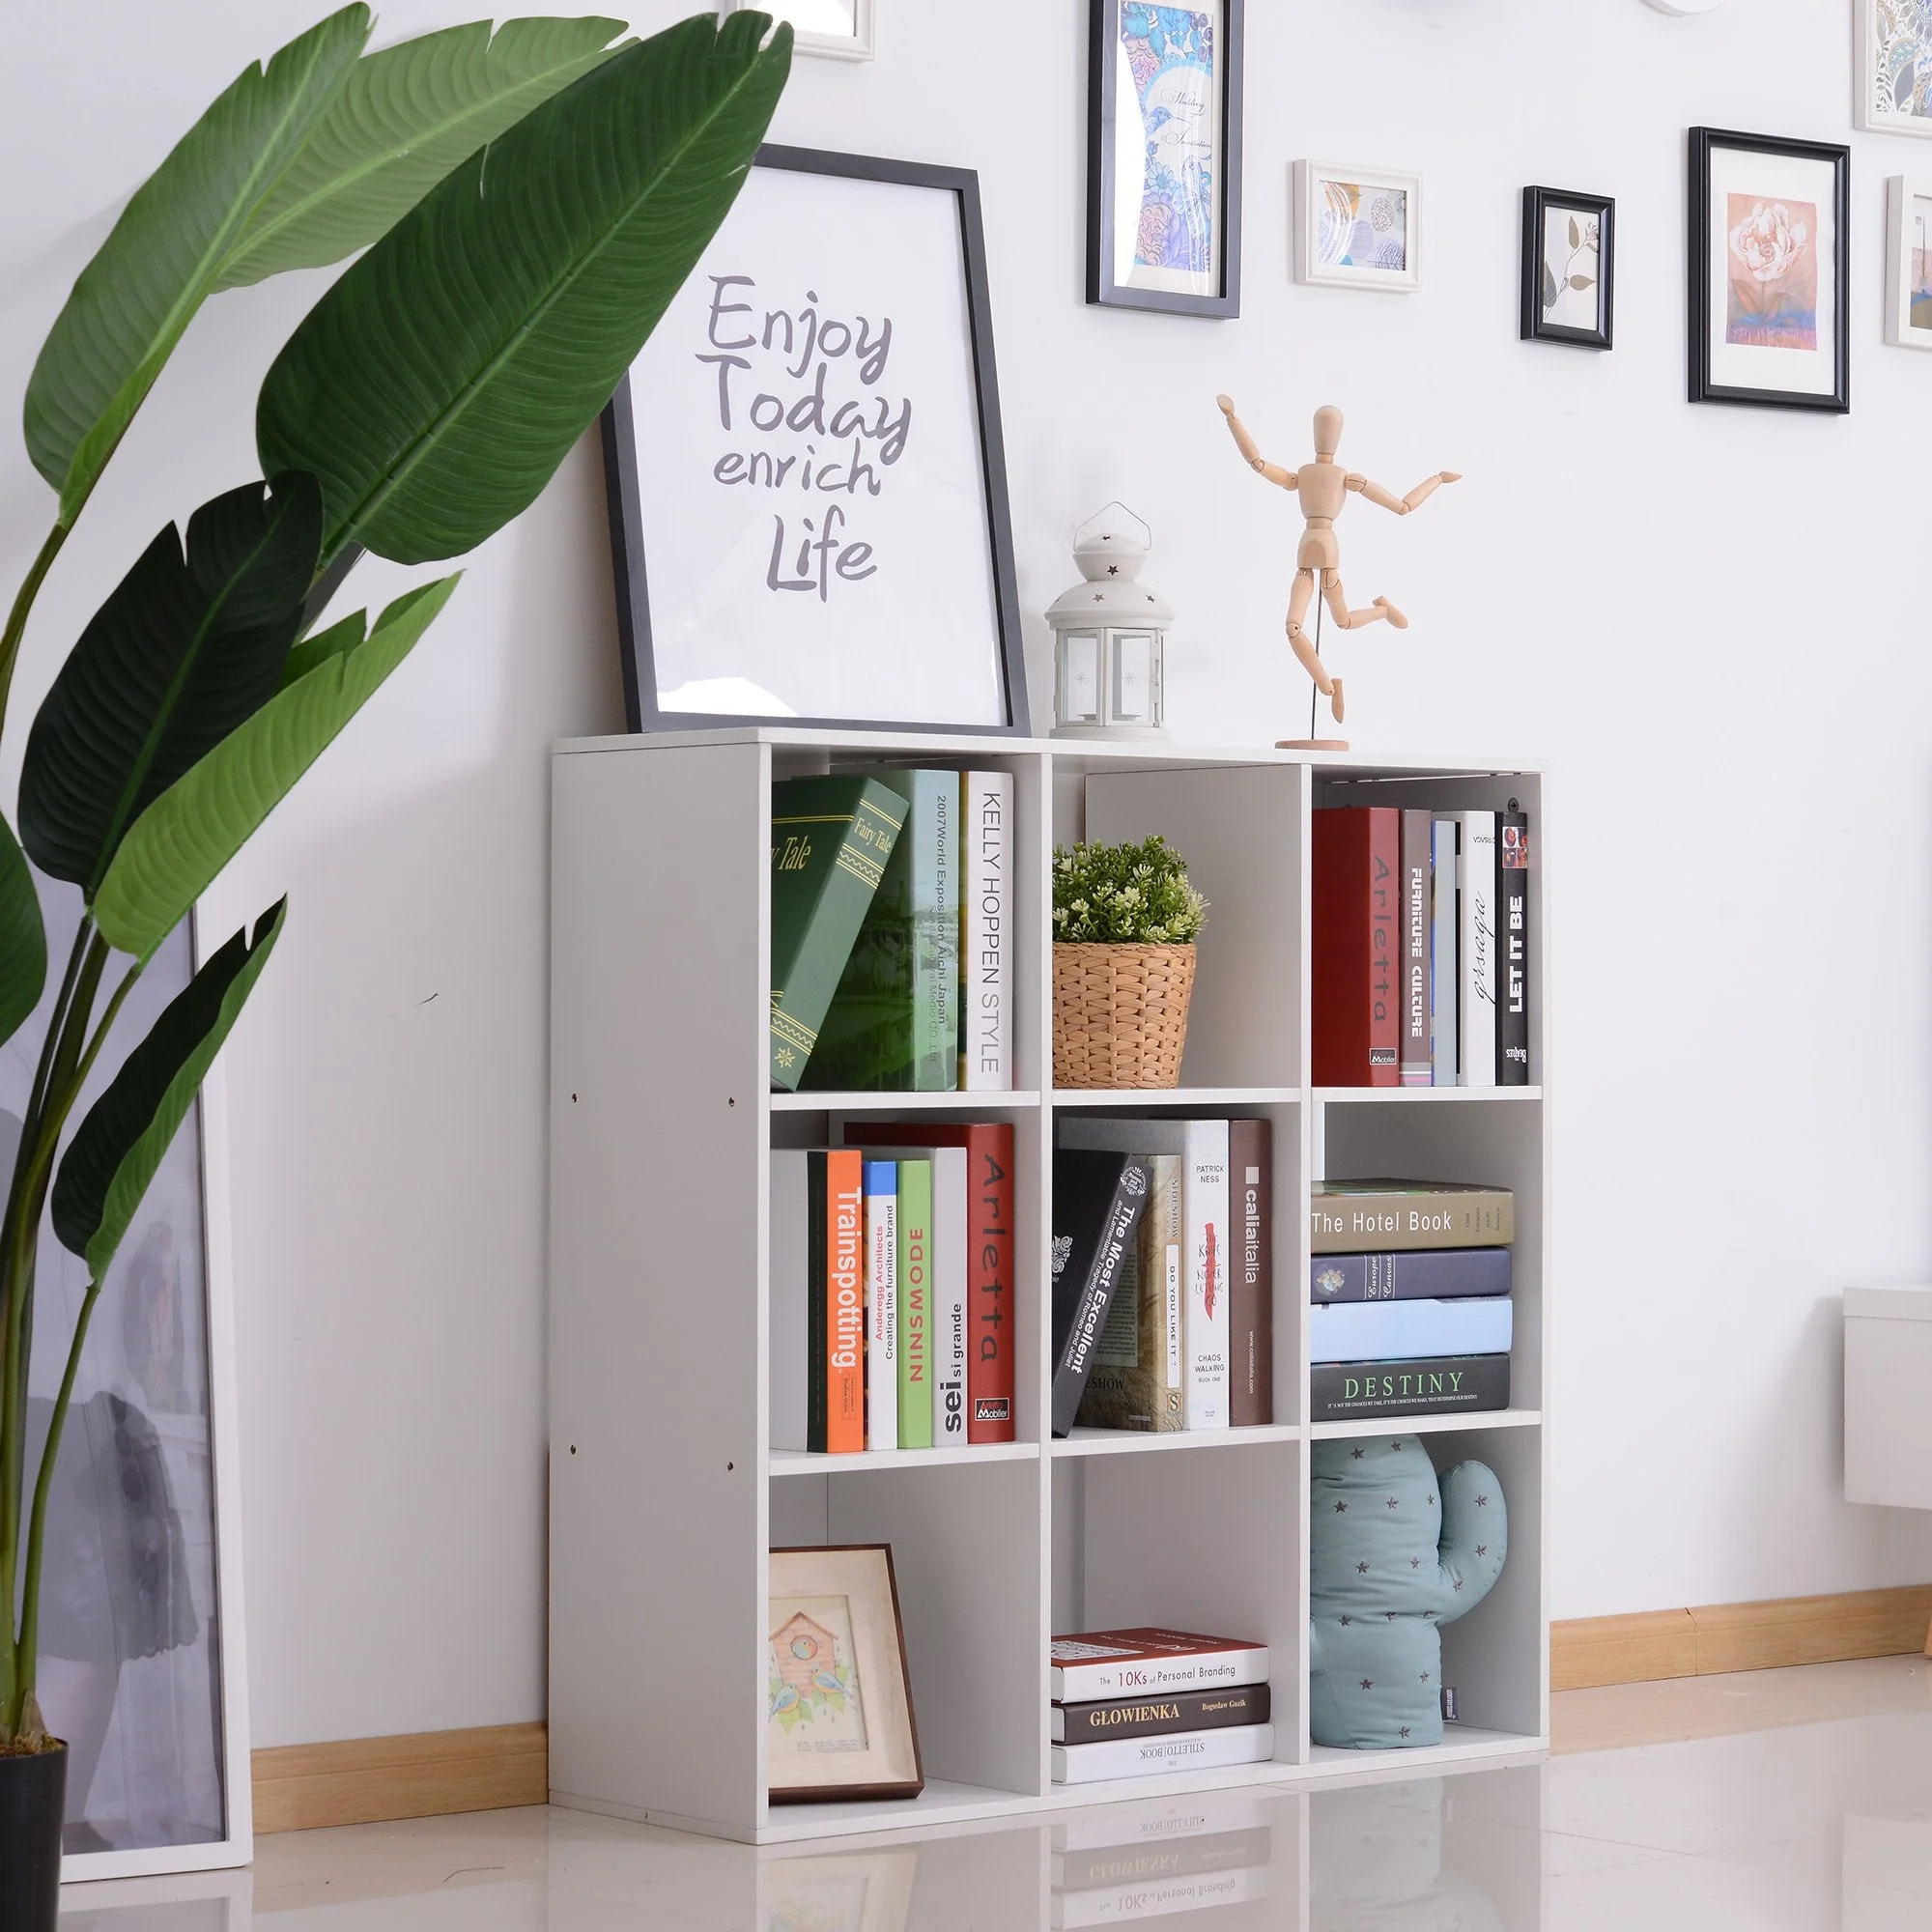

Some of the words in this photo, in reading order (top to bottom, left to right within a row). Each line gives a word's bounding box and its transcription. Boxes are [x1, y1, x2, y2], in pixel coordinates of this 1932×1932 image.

[708, 275, 892, 385] Enjoy
[695, 354, 912, 466] Today
[713, 438, 881, 496] enrich
[766, 504, 878, 603] Life
[778, 835, 811, 870] Tale
[854, 817, 876, 846] Fairy
[875, 830, 892, 854] Tale
[982, 793, 1001, 869] KELLY
[935, 870, 947, 941] Exposition
[1509, 895, 1523, 930] BE
[981, 878, 1001, 983] HOPPEN
[1373, 855, 1392, 1022] Arletta
[1509, 935, 1523, 960] IT
[937, 946, 947, 980] Aichi
[936, 983, 947, 1024] Japan
[1411, 966, 1423, 1037] CULTURE
[1509, 965, 1523, 1012] LET
[980, 993, 1000, 1073] STYLE
[1115, 1200, 1123, 1216] and
[1115, 1206, 1136, 1238] The
[1312, 1211, 1344, 1233] The
[1353, 1210, 1400, 1233] Hotel
[1408, 1210, 1452, 1231] Book
[875, 1225, 884, 1283] Architects
[980, 1152, 1007, 1362] Arletta
[1100, 1216, 1120, 1260] Lamentable
[1244, 1189, 1260, 1284] caliaitalia
[832, 1186, 862, 1368] Trainspotting
[1090, 1262, 1105, 1293] Tragedy
[1099, 1241, 1123, 1288] Most
[1170, 1265, 1177, 1283] DO
[1368, 1256, 1379, 1298] Europe
[1383, 1254, 1392, 1298] Canvas
[875, 1286, 885, 1340] Anderegg
[909, 1229, 923, 1382] NINSMODE
[1077, 1301, 1092, 1330] Romeo
[1087, 1293, 1094, 1303] of
[886, 1312, 895, 1360] Creating
[951, 1303, 964, 1359] grande
[1071, 1289, 1108, 1374] Excellent
[1072, 1330, 1081, 1347] and
[1170, 1343, 1177, 1357] IT
[951, 1364, 962, 1378] si
[1065, 1346, 1076, 1368] Juliet
[1194, 1364, 1225, 1373] WALKING
[1198, 1354, 1222, 1363] CHAOS
[1085, 1377, 1125, 1391] ESHOW
[1344, 1372, 1463, 1399] DESTINY
[940, 1381, 962, 1433] sei
[1099, 1677, 1111, 1686] The
[1119, 1670, 1148, 1687] 10Ks
[1157, 1667, 1196, 1682] Personal
[1199, 1664, 1236, 1677] Branding
[1229, 1699, 1246, 1708] Guzik
